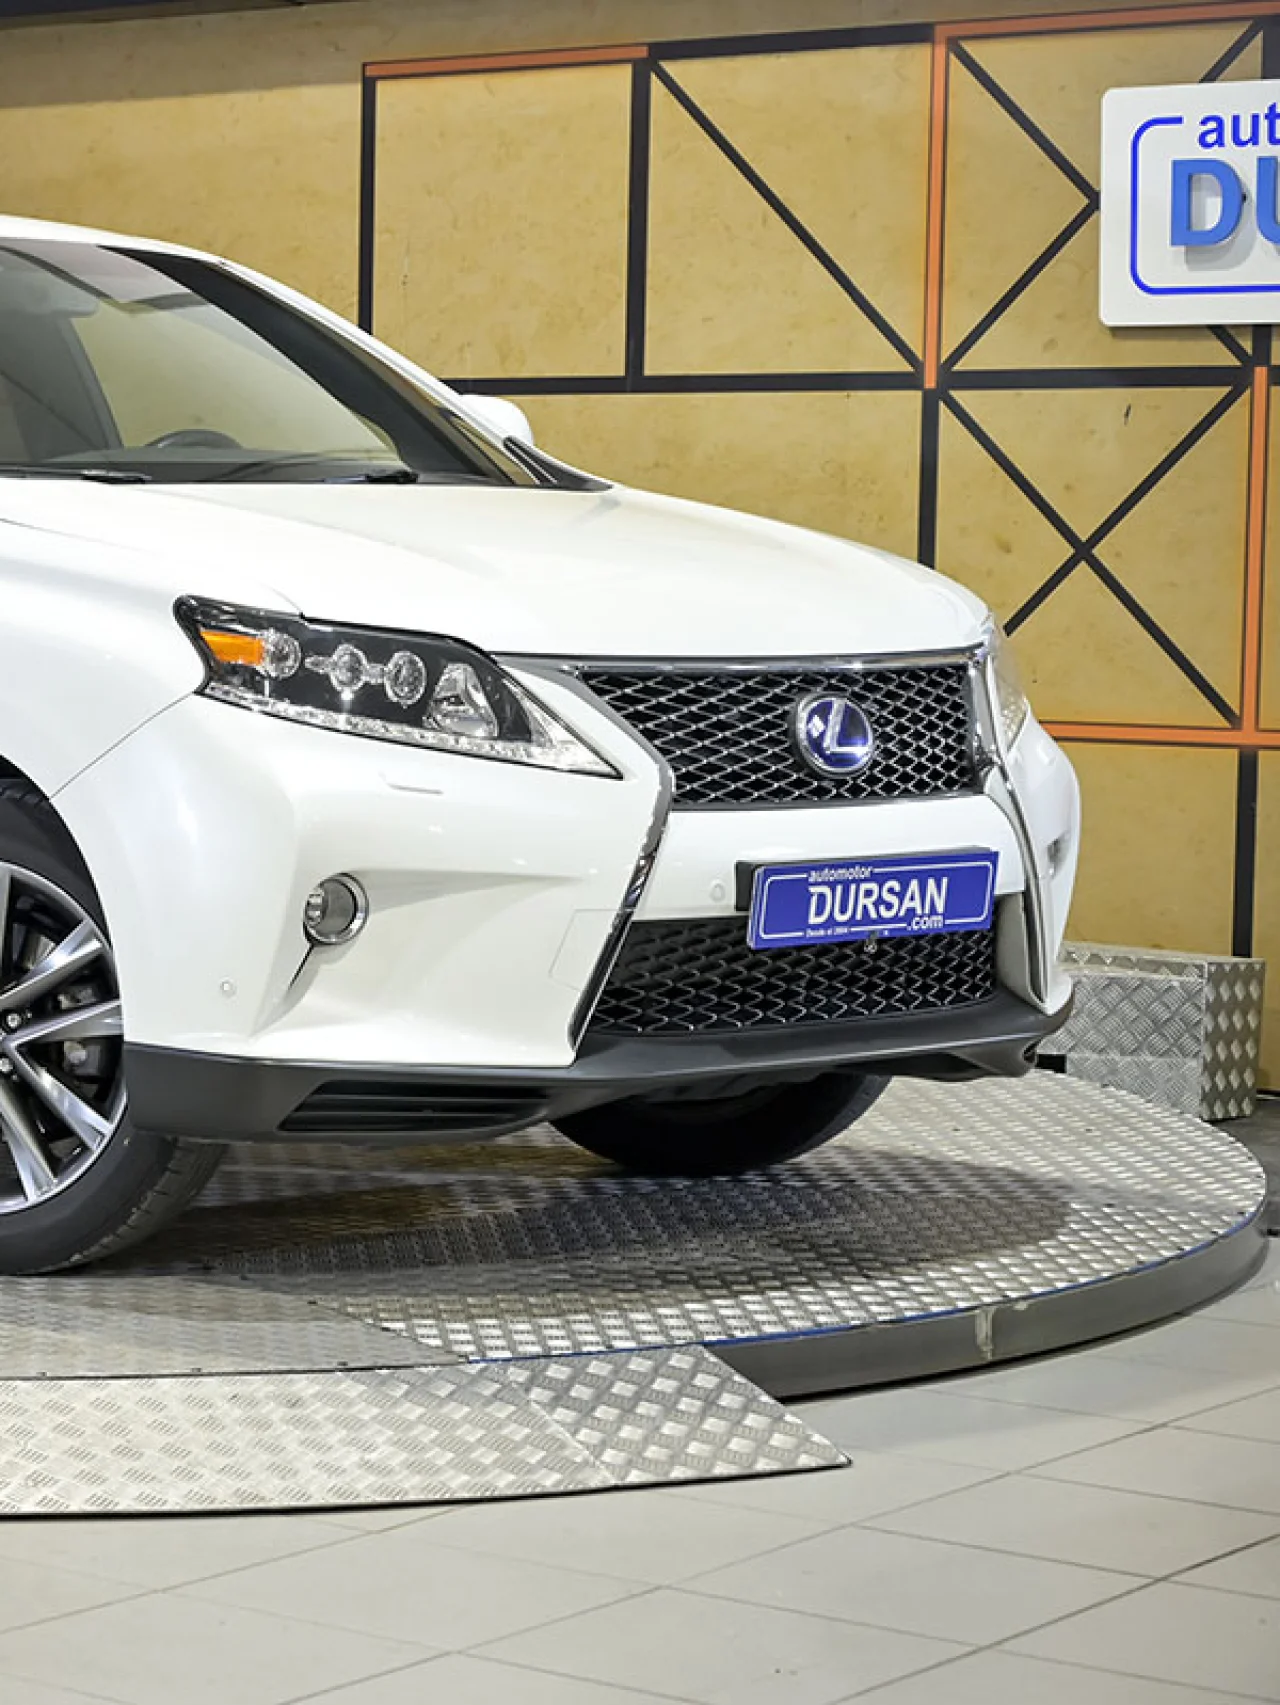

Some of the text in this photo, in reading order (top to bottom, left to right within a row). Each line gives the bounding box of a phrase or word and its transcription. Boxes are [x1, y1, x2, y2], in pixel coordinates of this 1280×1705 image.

[1197, 102, 1280, 149] aut
[808, 877, 948, 925] DURSAN
[907, 915, 943, 931] .com
